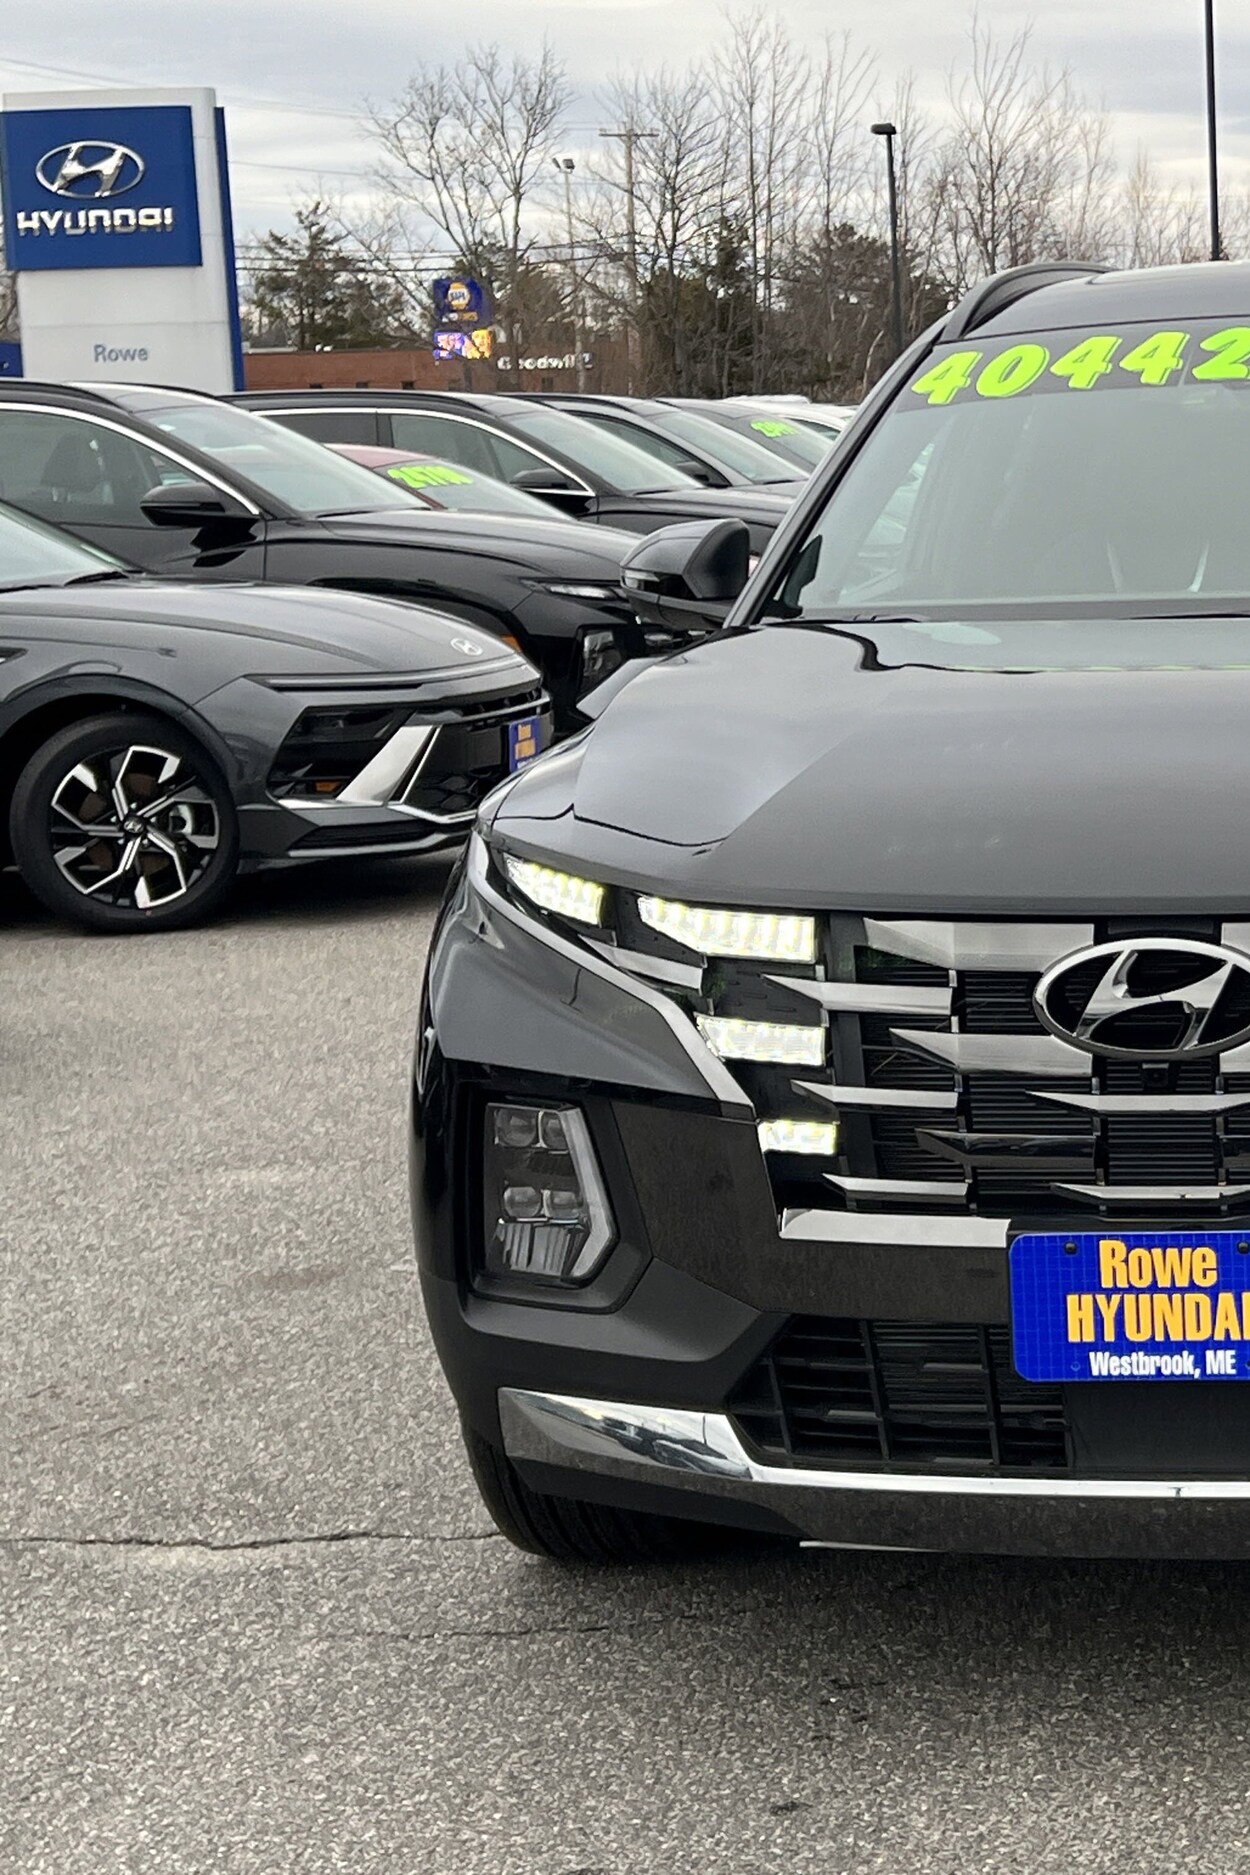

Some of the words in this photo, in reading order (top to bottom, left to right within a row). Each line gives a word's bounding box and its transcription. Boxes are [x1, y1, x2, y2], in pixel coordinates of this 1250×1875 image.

[17, 207, 173, 236] HYUNDAI
[93, 343, 149, 362] Rowe
[497, 353, 576, 370] Godwill
[1099, 1240, 1217, 1288] Rowe
[1089, 1351, 1201, 1379] Westbrook,
[1205, 1350, 1237, 1375] ME
